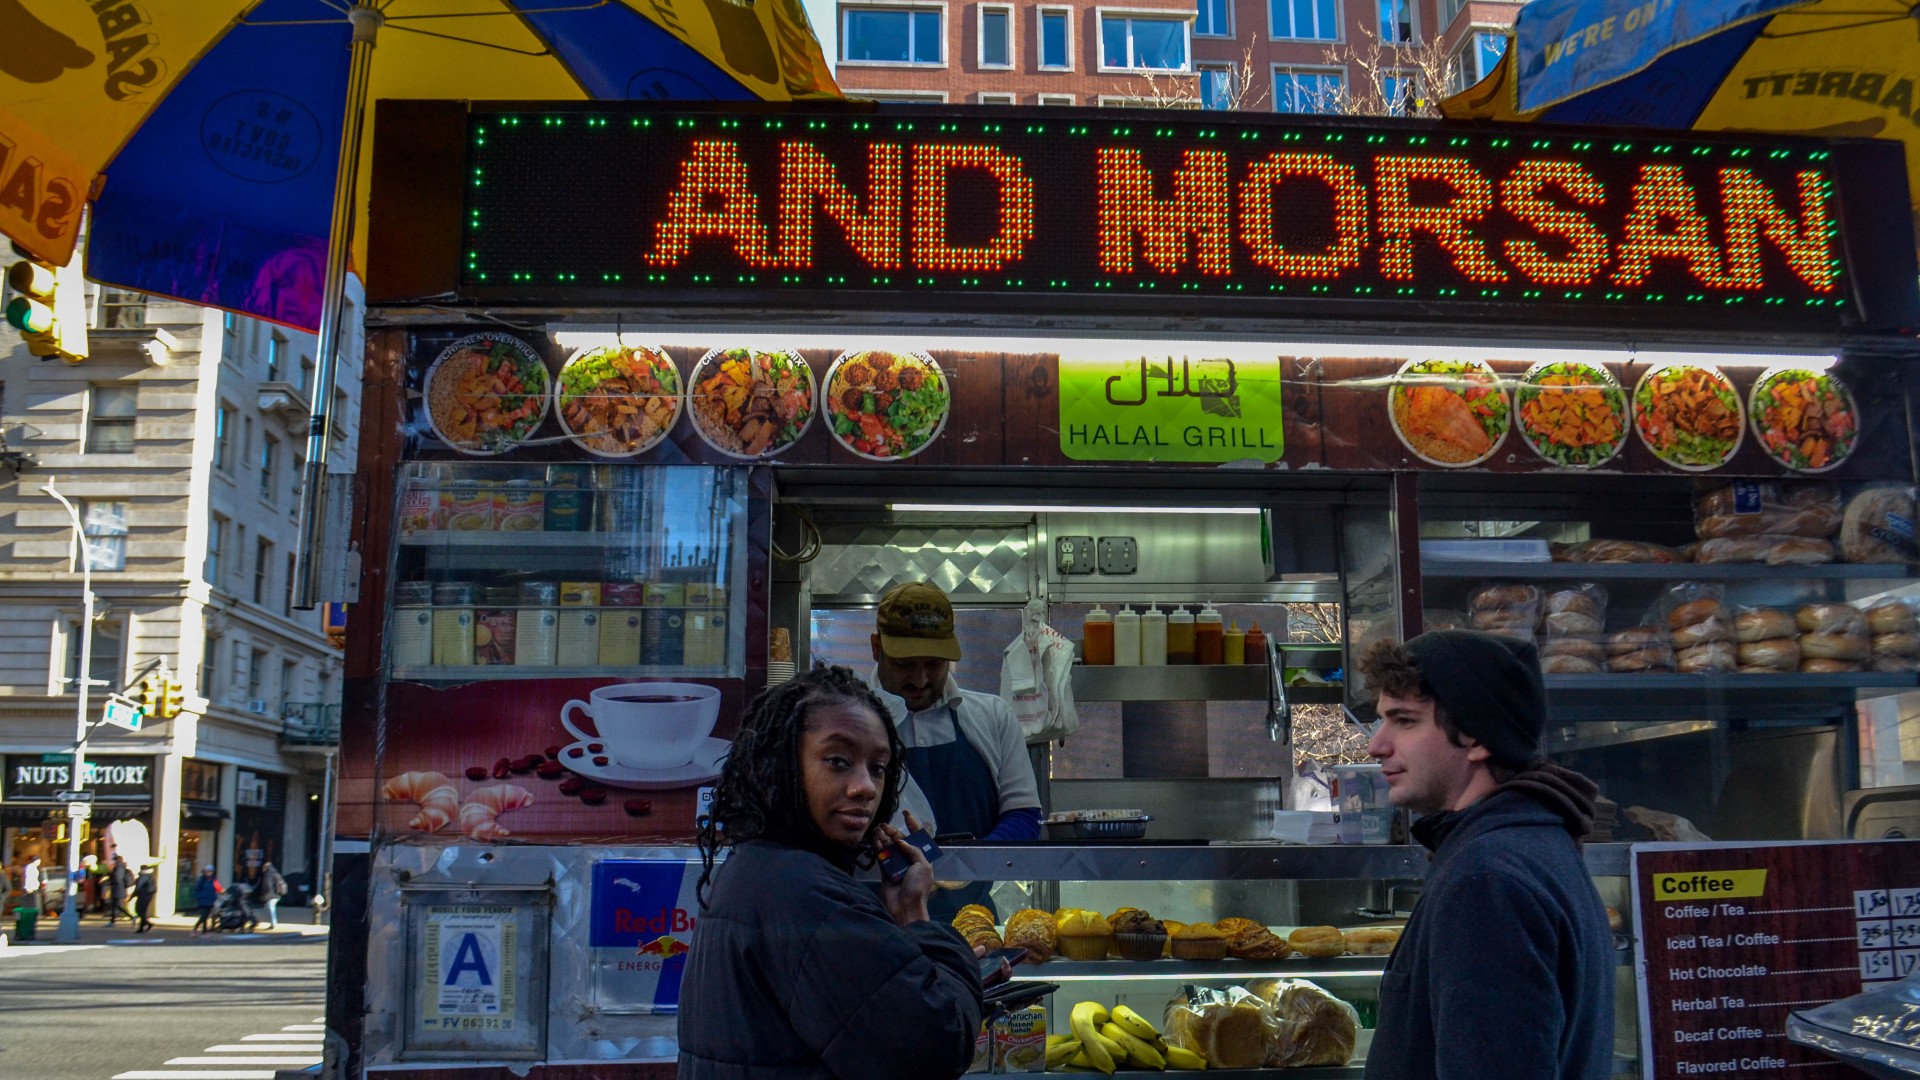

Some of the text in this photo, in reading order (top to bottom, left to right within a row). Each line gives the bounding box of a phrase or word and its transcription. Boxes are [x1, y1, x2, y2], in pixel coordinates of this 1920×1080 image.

[1543, 14, 1618, 67] WE'RE
[644, 138, 1839, 293] AND MORSAN
[441, 334, 485, 360] CHICKEN
[1069, 423, 1275, 448] HALAL GRILL
[16, 766, 148, 784] NUTS ACTORY
[1661, 875, 1735, 894] Coffee
[431, 906, 513, 914] MOBILE FOOD VENDOR
[1664, 905, 1710, 919] Coffee
[1720, 904, 1745, 917] Tea
[614, 907, 667, 933] Red
[1667, 936, 1697, 950] Iced
[1699, 936, 1724, 949] Tea
[1735, 933, 1780, 947] Coffee
[444, 932, 493, 986] A
[618, 960, 664, 971] ENERG
[1669, 964, 1767, 981] Hot Chocolate
[1671, 996, 1745, 1012] Herbal Tea
[443, 1018, 460, 1029] FV
[462, 1018, 499, 1029] 06391
[1009, 1012, 1043, 1020] aruchan
[1674, 1026, 1763, 1043] Decaf Coffee
[1676, 1056, 1786, 1075] Flavored Coffee
